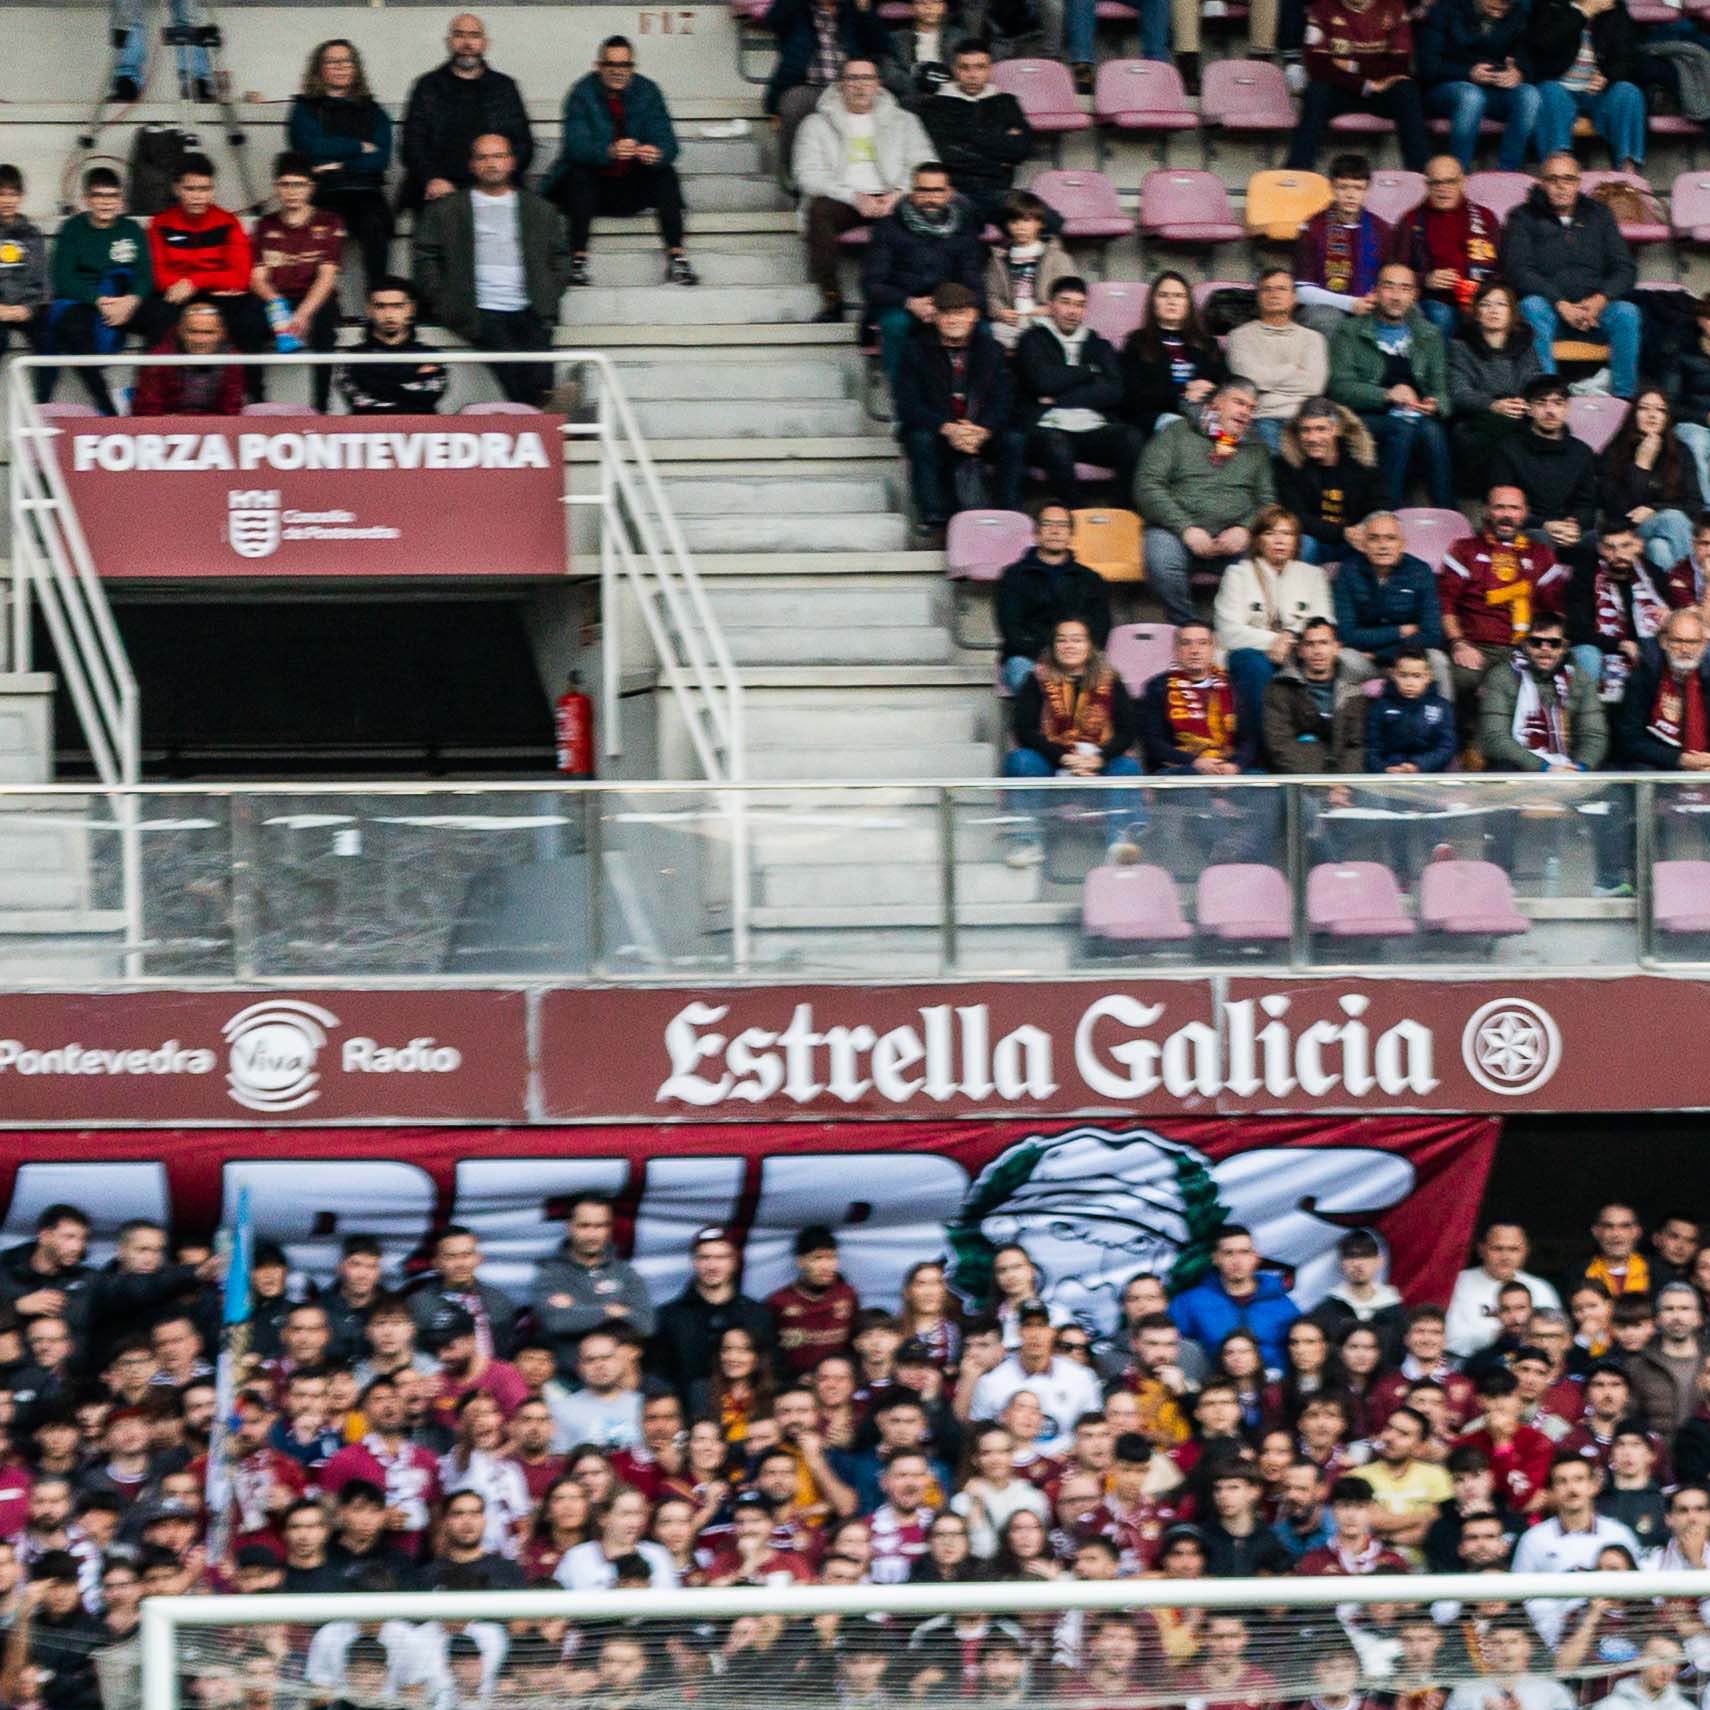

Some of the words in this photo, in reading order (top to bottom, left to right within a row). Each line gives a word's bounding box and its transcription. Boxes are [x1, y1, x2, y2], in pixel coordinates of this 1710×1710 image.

[74, 435, 236, 471] FORZA
[238, 432, 549, 470] PONTEVEDRA
[0, 1038, 218, 1076] Pontevedra
[238, 1038, 303, 1074] Viva
[656, 1001, 1060, 1106] Estrella
[1074, 994, 1440, 1100] Galicia
